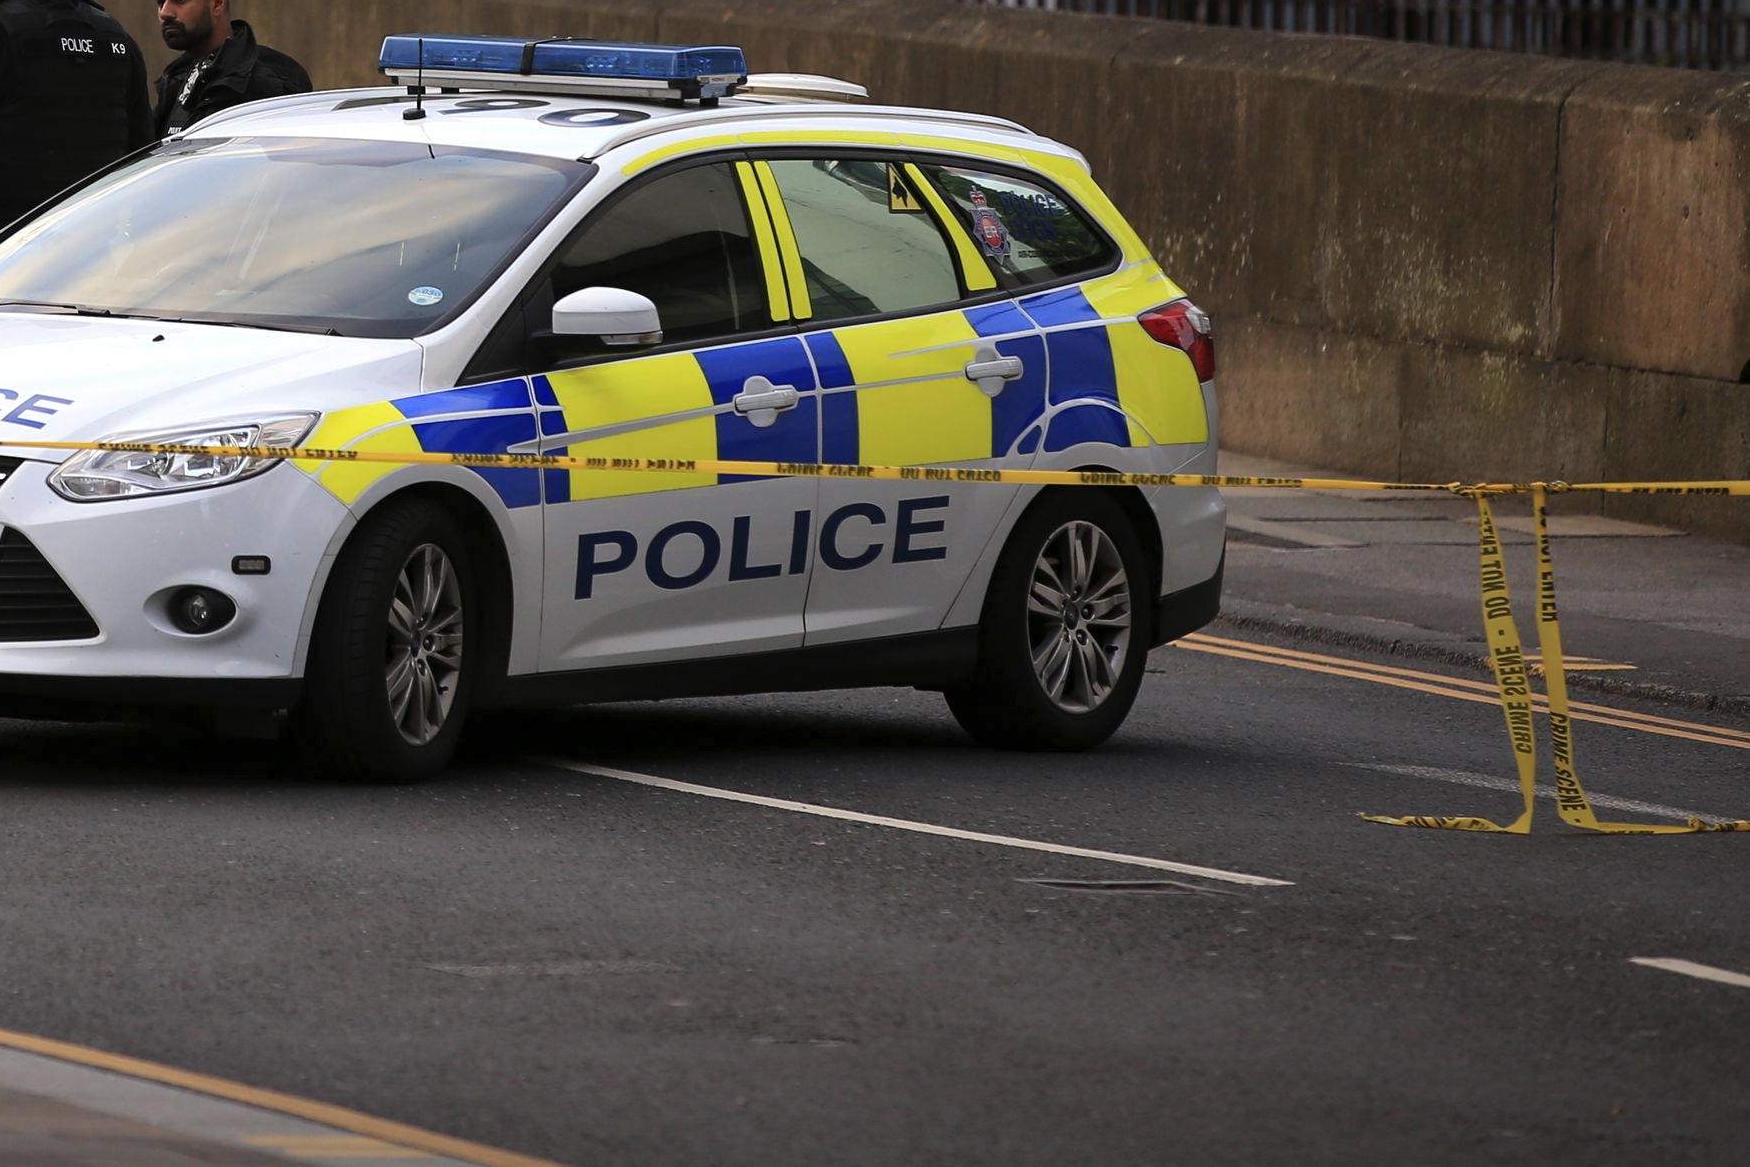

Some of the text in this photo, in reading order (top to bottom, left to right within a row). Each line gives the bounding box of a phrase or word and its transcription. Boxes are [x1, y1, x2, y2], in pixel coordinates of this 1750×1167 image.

[61, 37, 126, 55] POLICE K9
[574, 495, 950, 600] POLICE
[1555, 762, 1587, 812] SCENE
